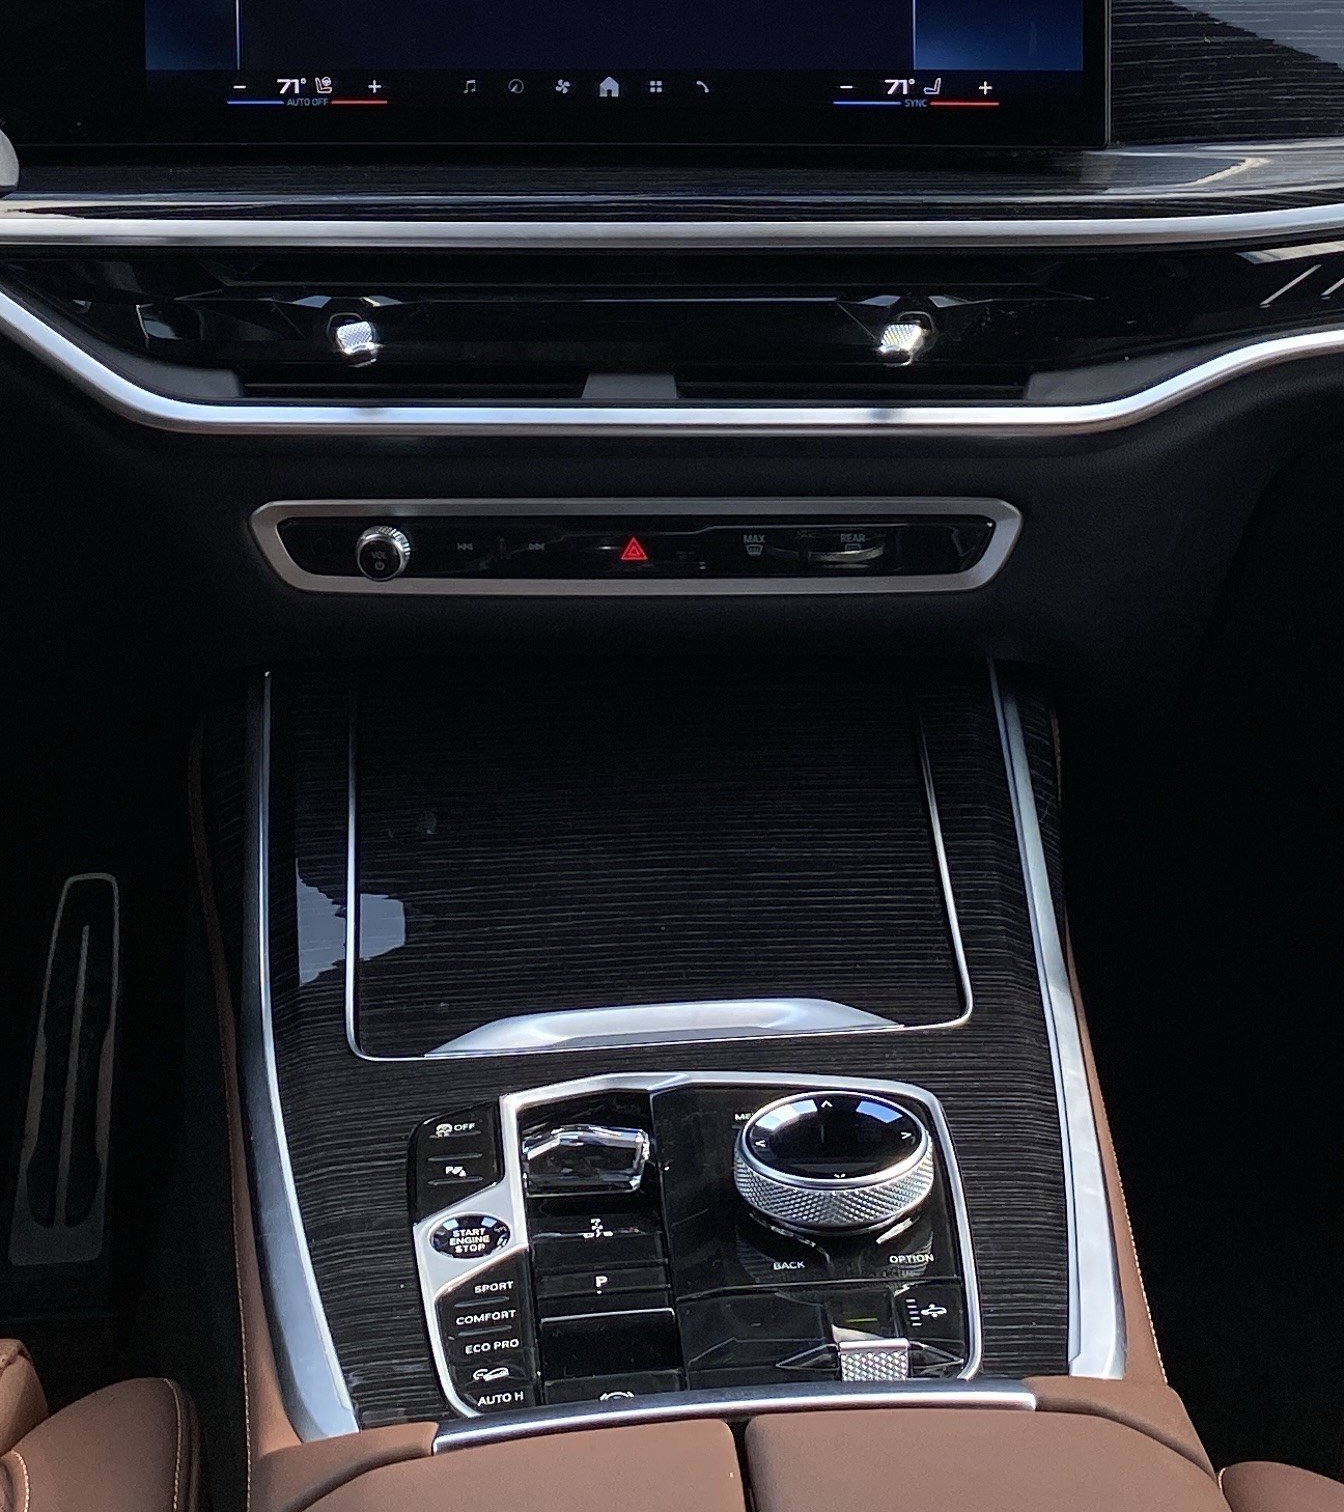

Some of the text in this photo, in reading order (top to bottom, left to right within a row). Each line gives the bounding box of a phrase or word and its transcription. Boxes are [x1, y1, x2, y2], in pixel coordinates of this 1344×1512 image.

[287, 98, 329, 107] AUTO OFF
[905, 99, 927, 107] SYNC
[744, 535, 765, 543] MAX
[841, 534, 865, 542] REAR
[454, 1123, 475, 1131] OFF
[453, 1228, 486, 1237] START
[450, 1235, 490, 1246] ENGINE
[455, 1244, 486, 1253] STOP
[889, 1254, 934, 1264] OPTION
[773, 1261, 805, 1271] BACK
[595, 1276, 607, 1287] P
[475, 1281, 514, 1294] SPORT
[456, 1309, 516, 1326] COMFORT
[465, 1338, 519, 1355] ECO PRO
[477, 1391, 524, 1407] AUTO H
